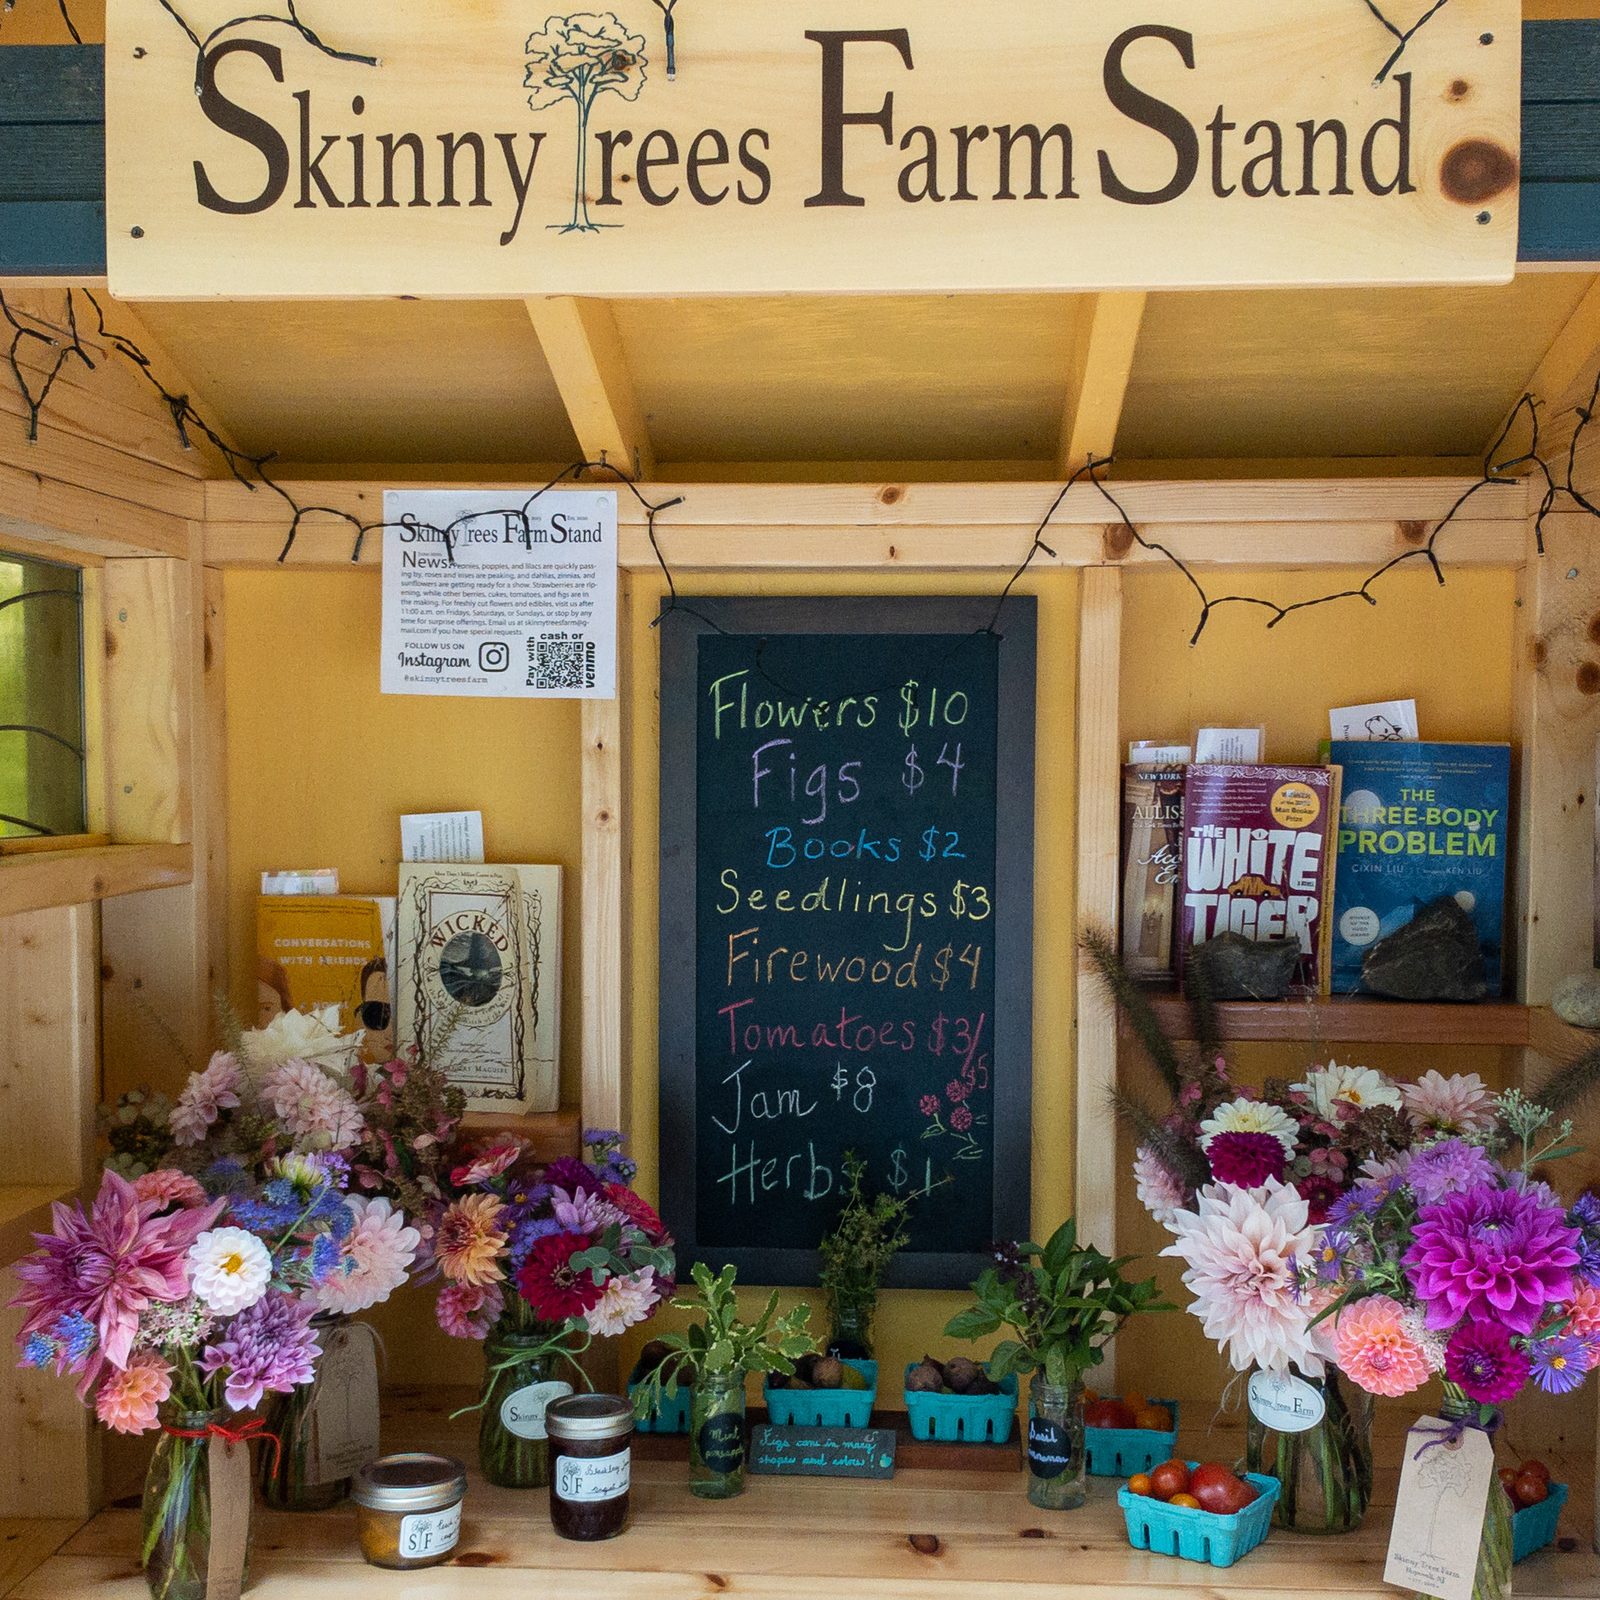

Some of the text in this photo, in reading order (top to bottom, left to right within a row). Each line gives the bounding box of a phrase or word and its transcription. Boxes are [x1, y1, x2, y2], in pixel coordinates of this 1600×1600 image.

[193, 38, 547, 246] Skinny
[803, 27, 1080, 208] Farm
[1096, 23, 1418, 206] Stand
[550, 513, 602, 543] Stand
[540, 632, 568, 640] cash
[398, 652, 472, 674] Instagram
[526, 636, 536, 686] Pay with
[586, 642, 596, 688] venmo
[709, 669, 969, 740] Flowers $10
[752, 738, 863, 825] Figs
[1400, 788, 1435, 802] THE
[1190, 824, 1225, 839] THE
[1340, 806, 1498, 828] THREE-BODY
[765, 825, 967, 869] Books $2
[1339, 830, 1497, 857] PROBLEM
[1352, 864, 1382, 873] CIXIN
[1387, 865, 1404, 873] LIU
[716, 868, 991, 951] Seedlings $3
[1184, 893, 1320, 954] TIGER
[274, 938, 371, 948] CONVERSATIONS
[430, 914, 509, 952] WICKED
[280, 956, 313, 965] WITH
[727, 927, 982, 991] Firewood $4
[718, 998, 916, 1055] Tomatoes
[711, 1060, 877, 1135] Jam $8
[886, 1148, 932, 1197] $1
[1294, 1397, 1314, 1416] Farm
[759, 1427, 790, 1452] Figs
[802, 1453, 828, 1466] and
